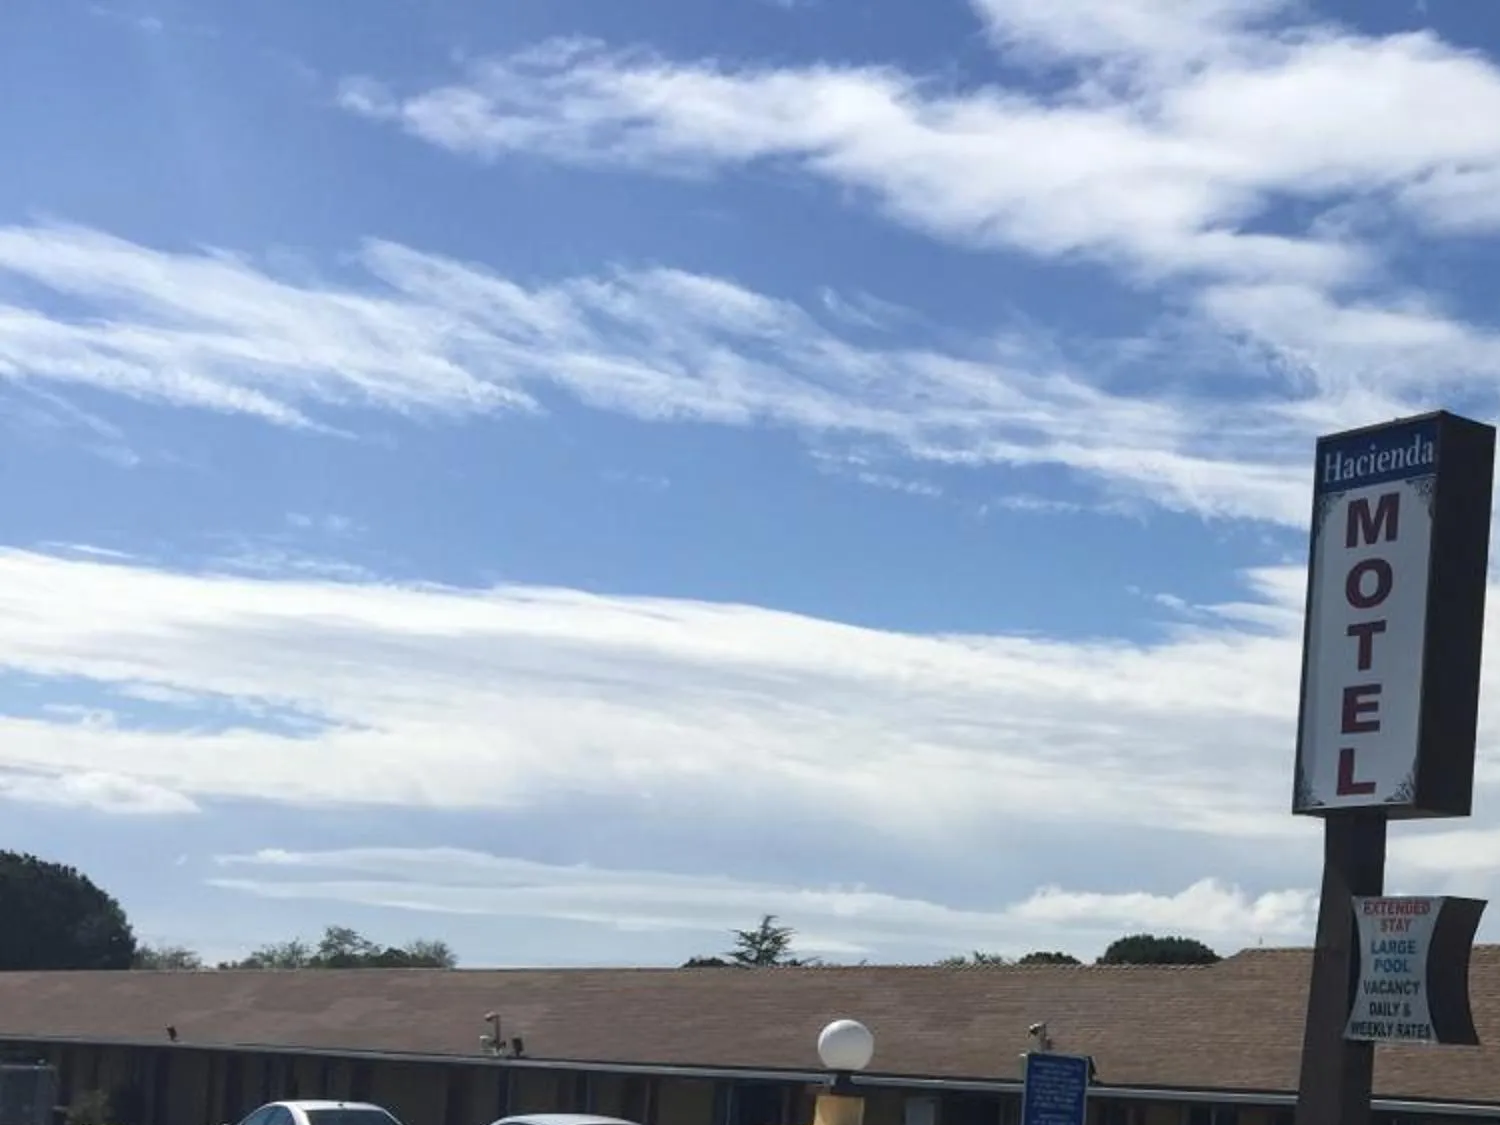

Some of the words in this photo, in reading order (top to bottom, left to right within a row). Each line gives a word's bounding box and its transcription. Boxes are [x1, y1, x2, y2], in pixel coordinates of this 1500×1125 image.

[1323, 433, 1434, 482] Hacienda
[1336, 492, 1400, 796] MOTEL
[1364, 901, 1431, 915] EXTENDED
[1380, 918, 1411, 932] STAY
[1371, 940, 1416, 954] LARGE
[1374, 958, 1411, 973] POOL
[1364, 980, 1420, 995] VACANCY
[1369, 1002, 1400, 1017] DAILY
[1403, 1003, 1411, 1017] &
[1352, 1022, 1393, 1038] WEEKLY
[1397, 1023, 1431, 1039] RATES
